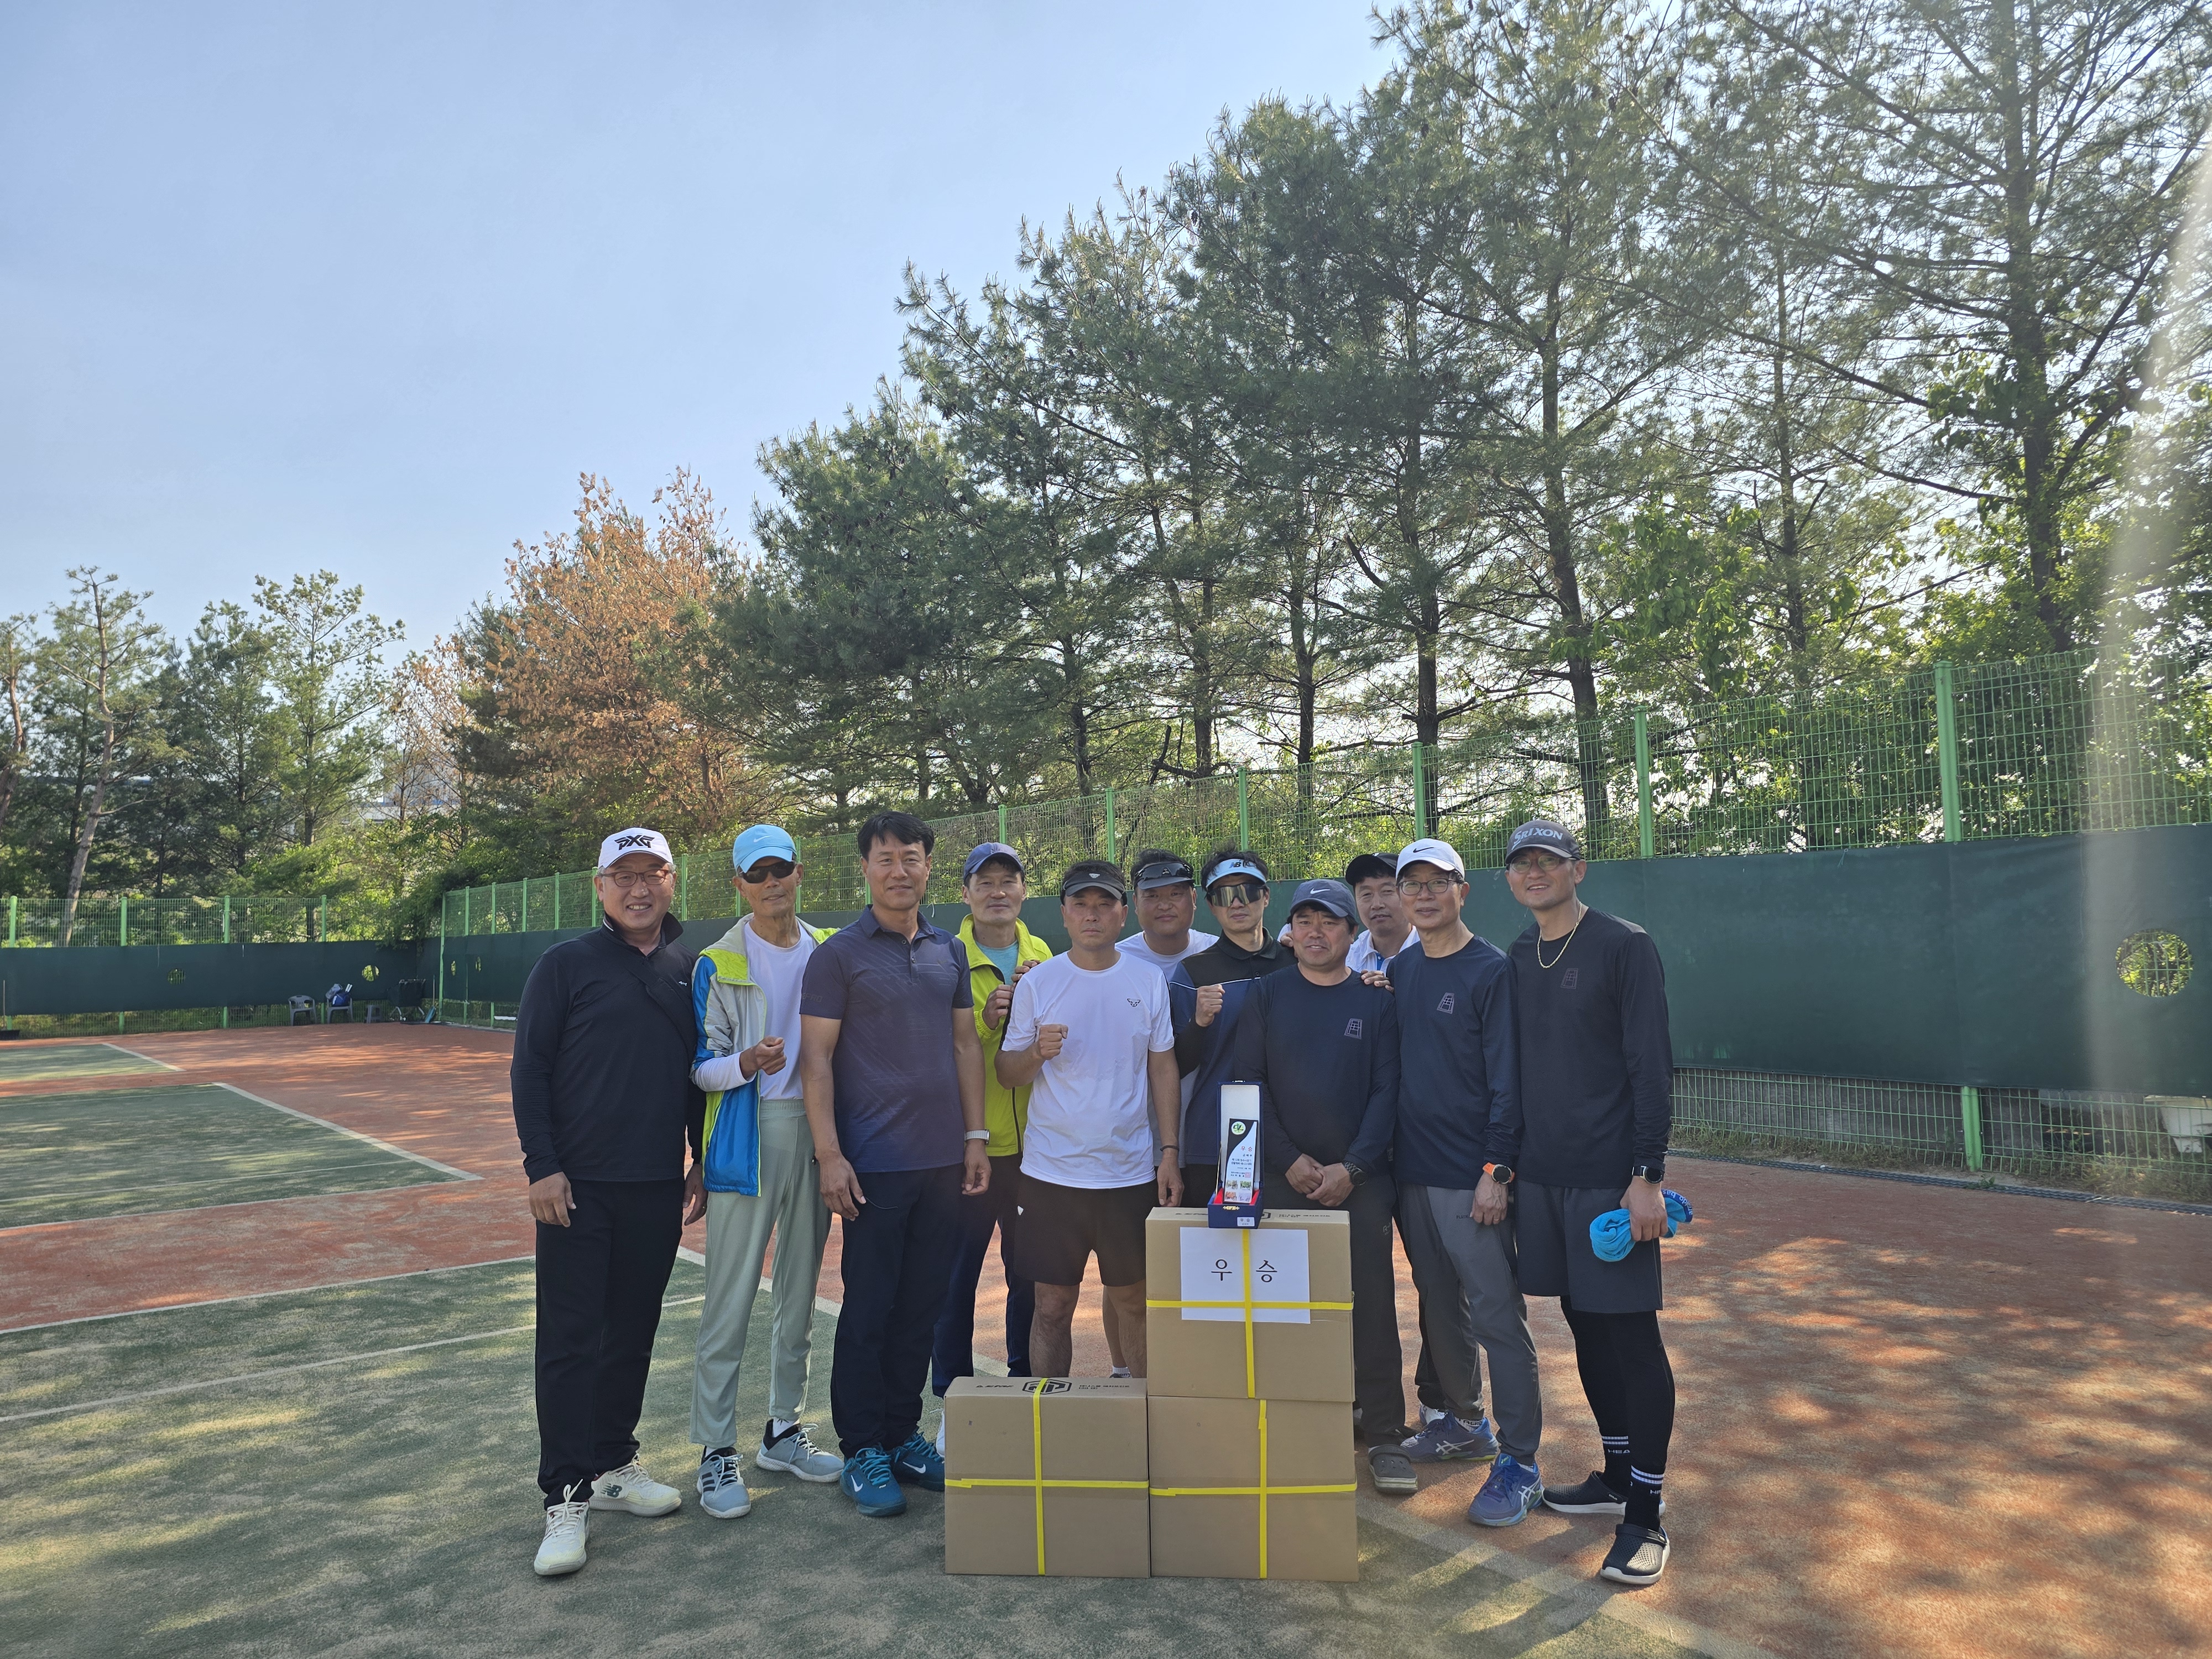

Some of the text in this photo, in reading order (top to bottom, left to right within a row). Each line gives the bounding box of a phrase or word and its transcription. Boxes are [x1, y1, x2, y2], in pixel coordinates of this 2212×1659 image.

[614, 834, 655, 851] PXG
[1511, 827, 1563, 850] SRIXON
[601, 1483, 623, 1498] NB
